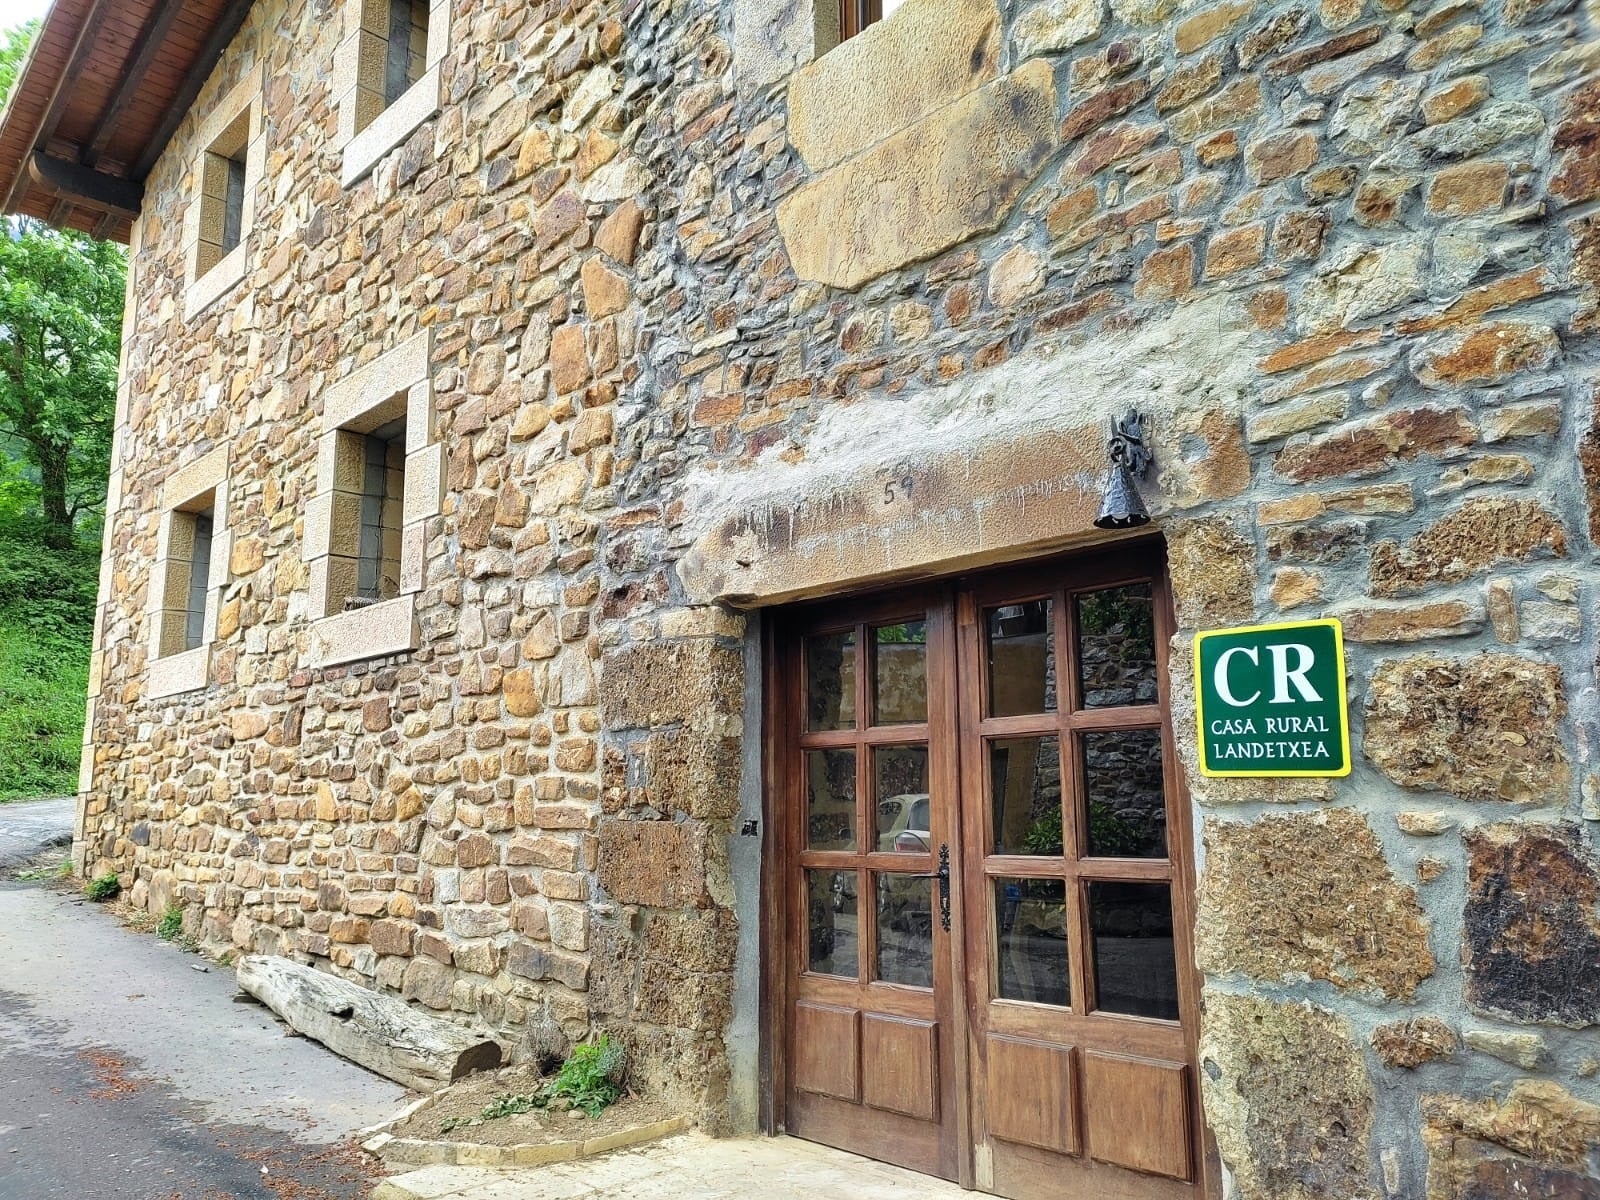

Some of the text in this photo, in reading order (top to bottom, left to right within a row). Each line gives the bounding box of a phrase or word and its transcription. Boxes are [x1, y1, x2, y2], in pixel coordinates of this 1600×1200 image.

[884, 475, 914, 505] 59
[1214, 643, 1323, 707] CR
[1211, 716, 1329, 735] CASA RURAL
[1213, 741, 1330, 759] LANDETXEA
